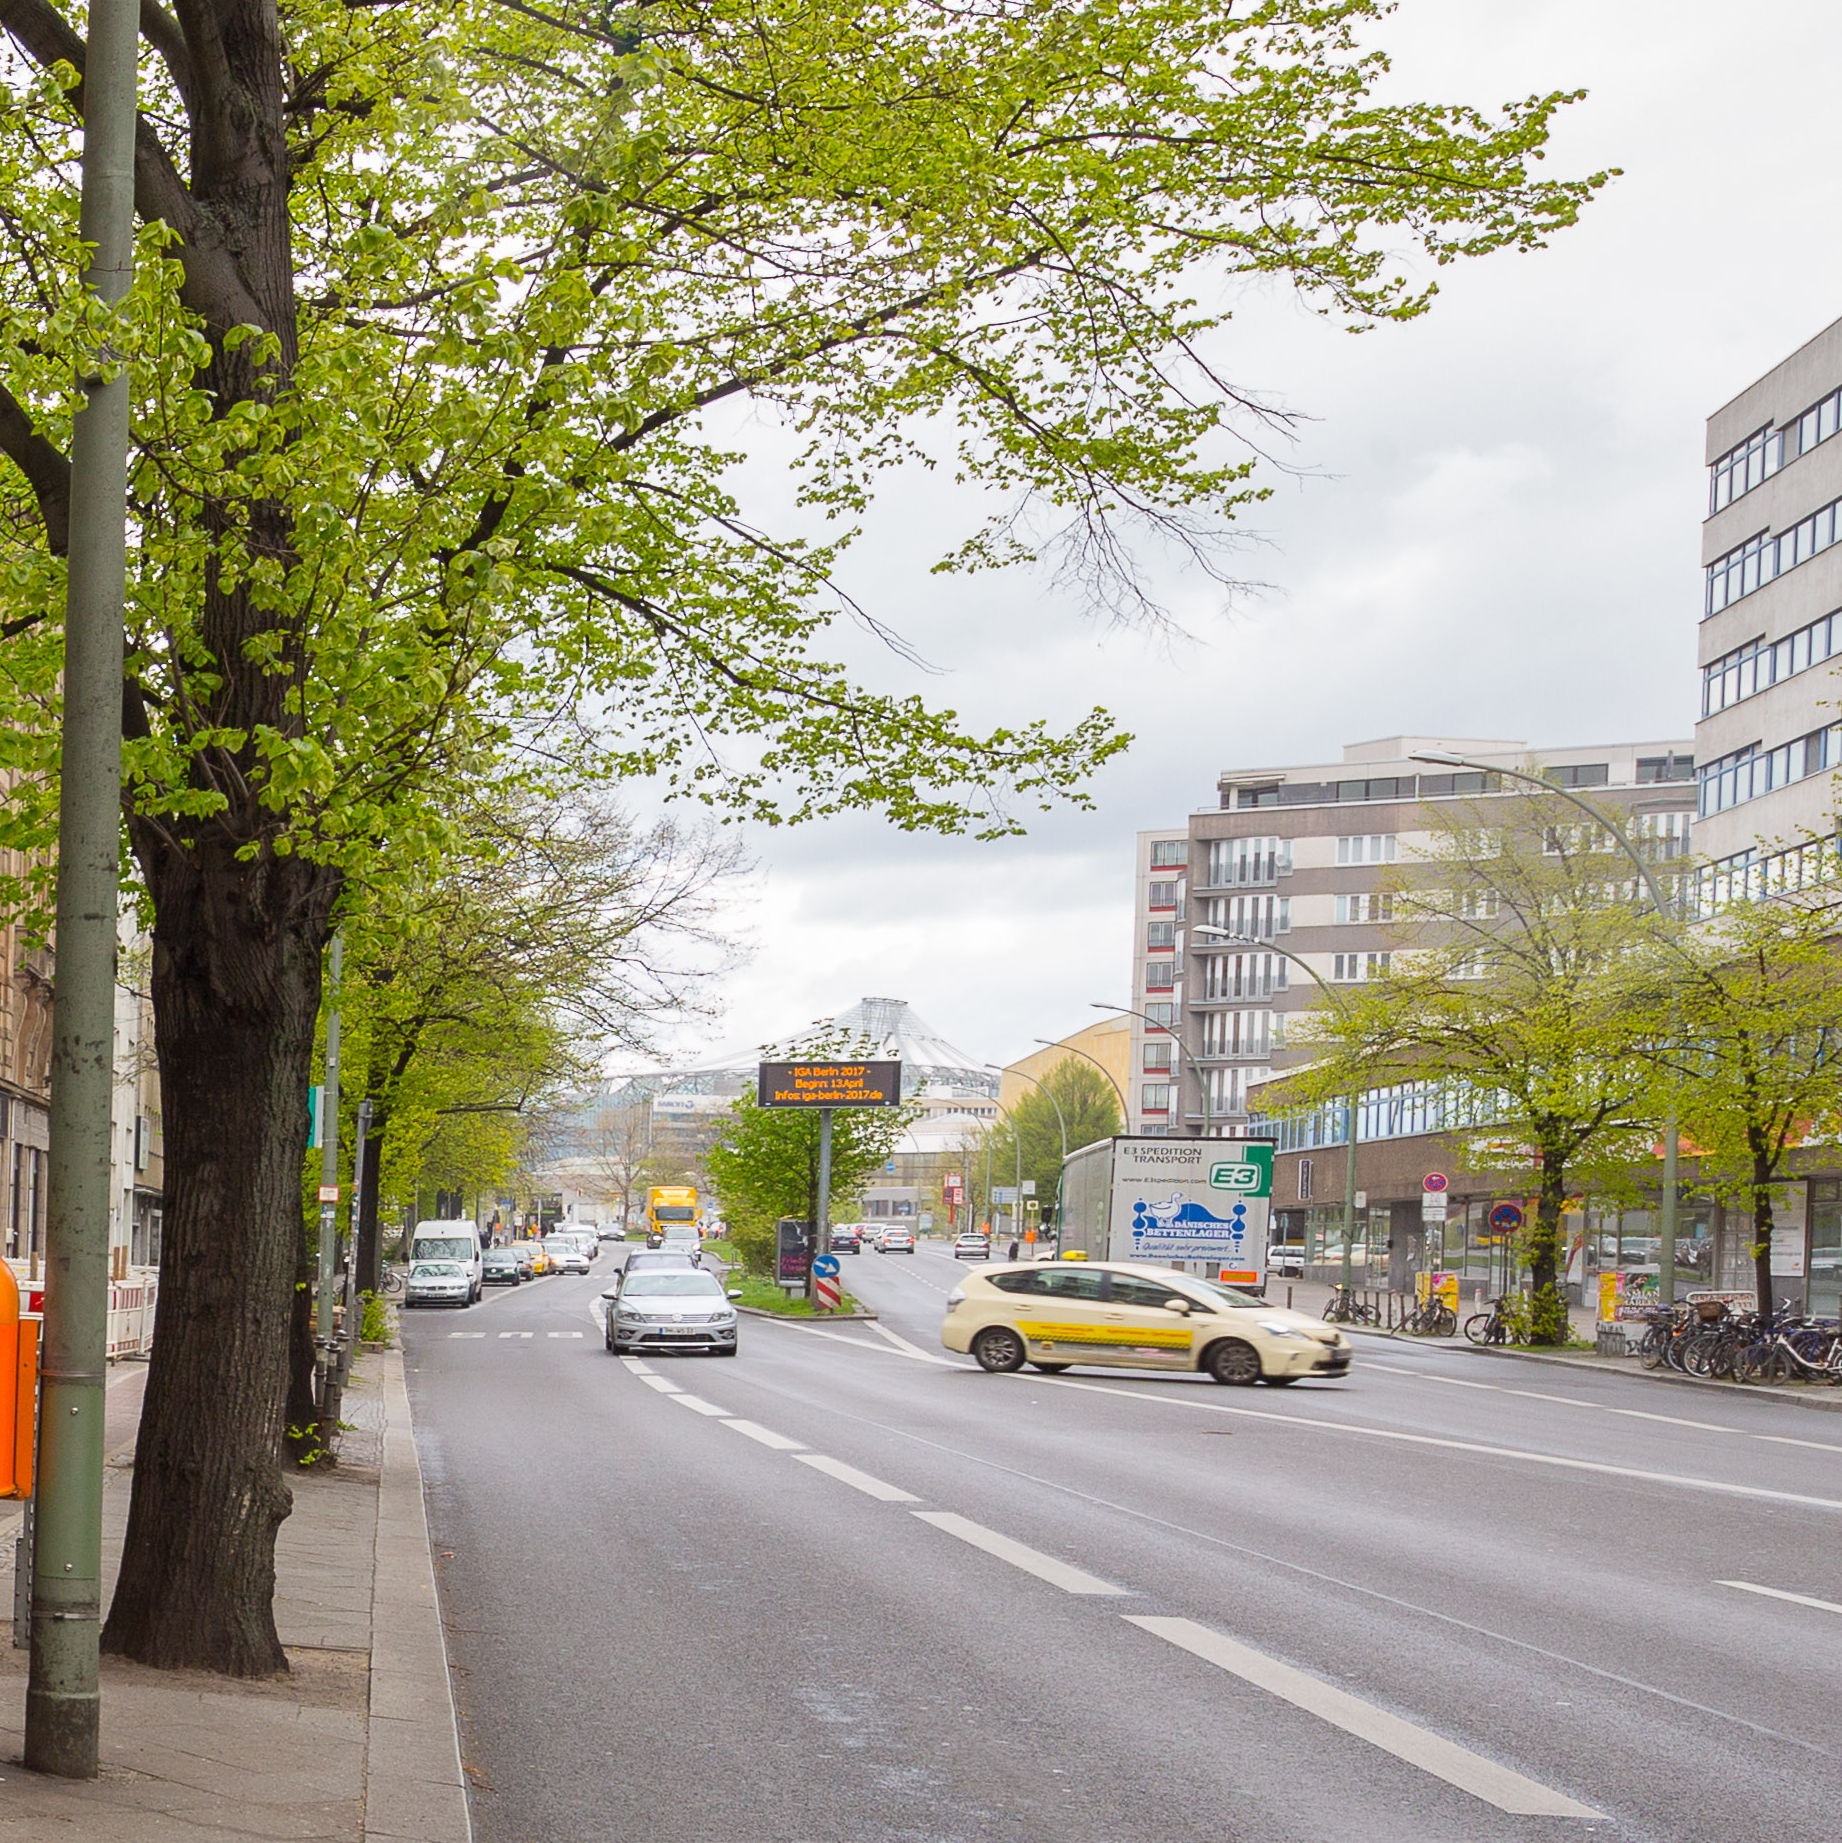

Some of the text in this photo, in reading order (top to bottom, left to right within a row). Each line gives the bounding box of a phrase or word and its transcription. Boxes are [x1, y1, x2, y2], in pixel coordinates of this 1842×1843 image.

[794, 1067, 811, 1077] IGA
[813, 1067, 838, 1076] Berlin
[840, 1067, 865, 1075] 2017
[1123, 1146, 1202, 1156] E3 SPEDITION
[1133, 1155, 1202, 1164] TRANSPORT
[1213, 1168, 1256, 1184] E3
[1174, 1219, 1230, 1228] DÄNISCHES
[1147, 1228, 1230, 1238] BETTENLAGER
